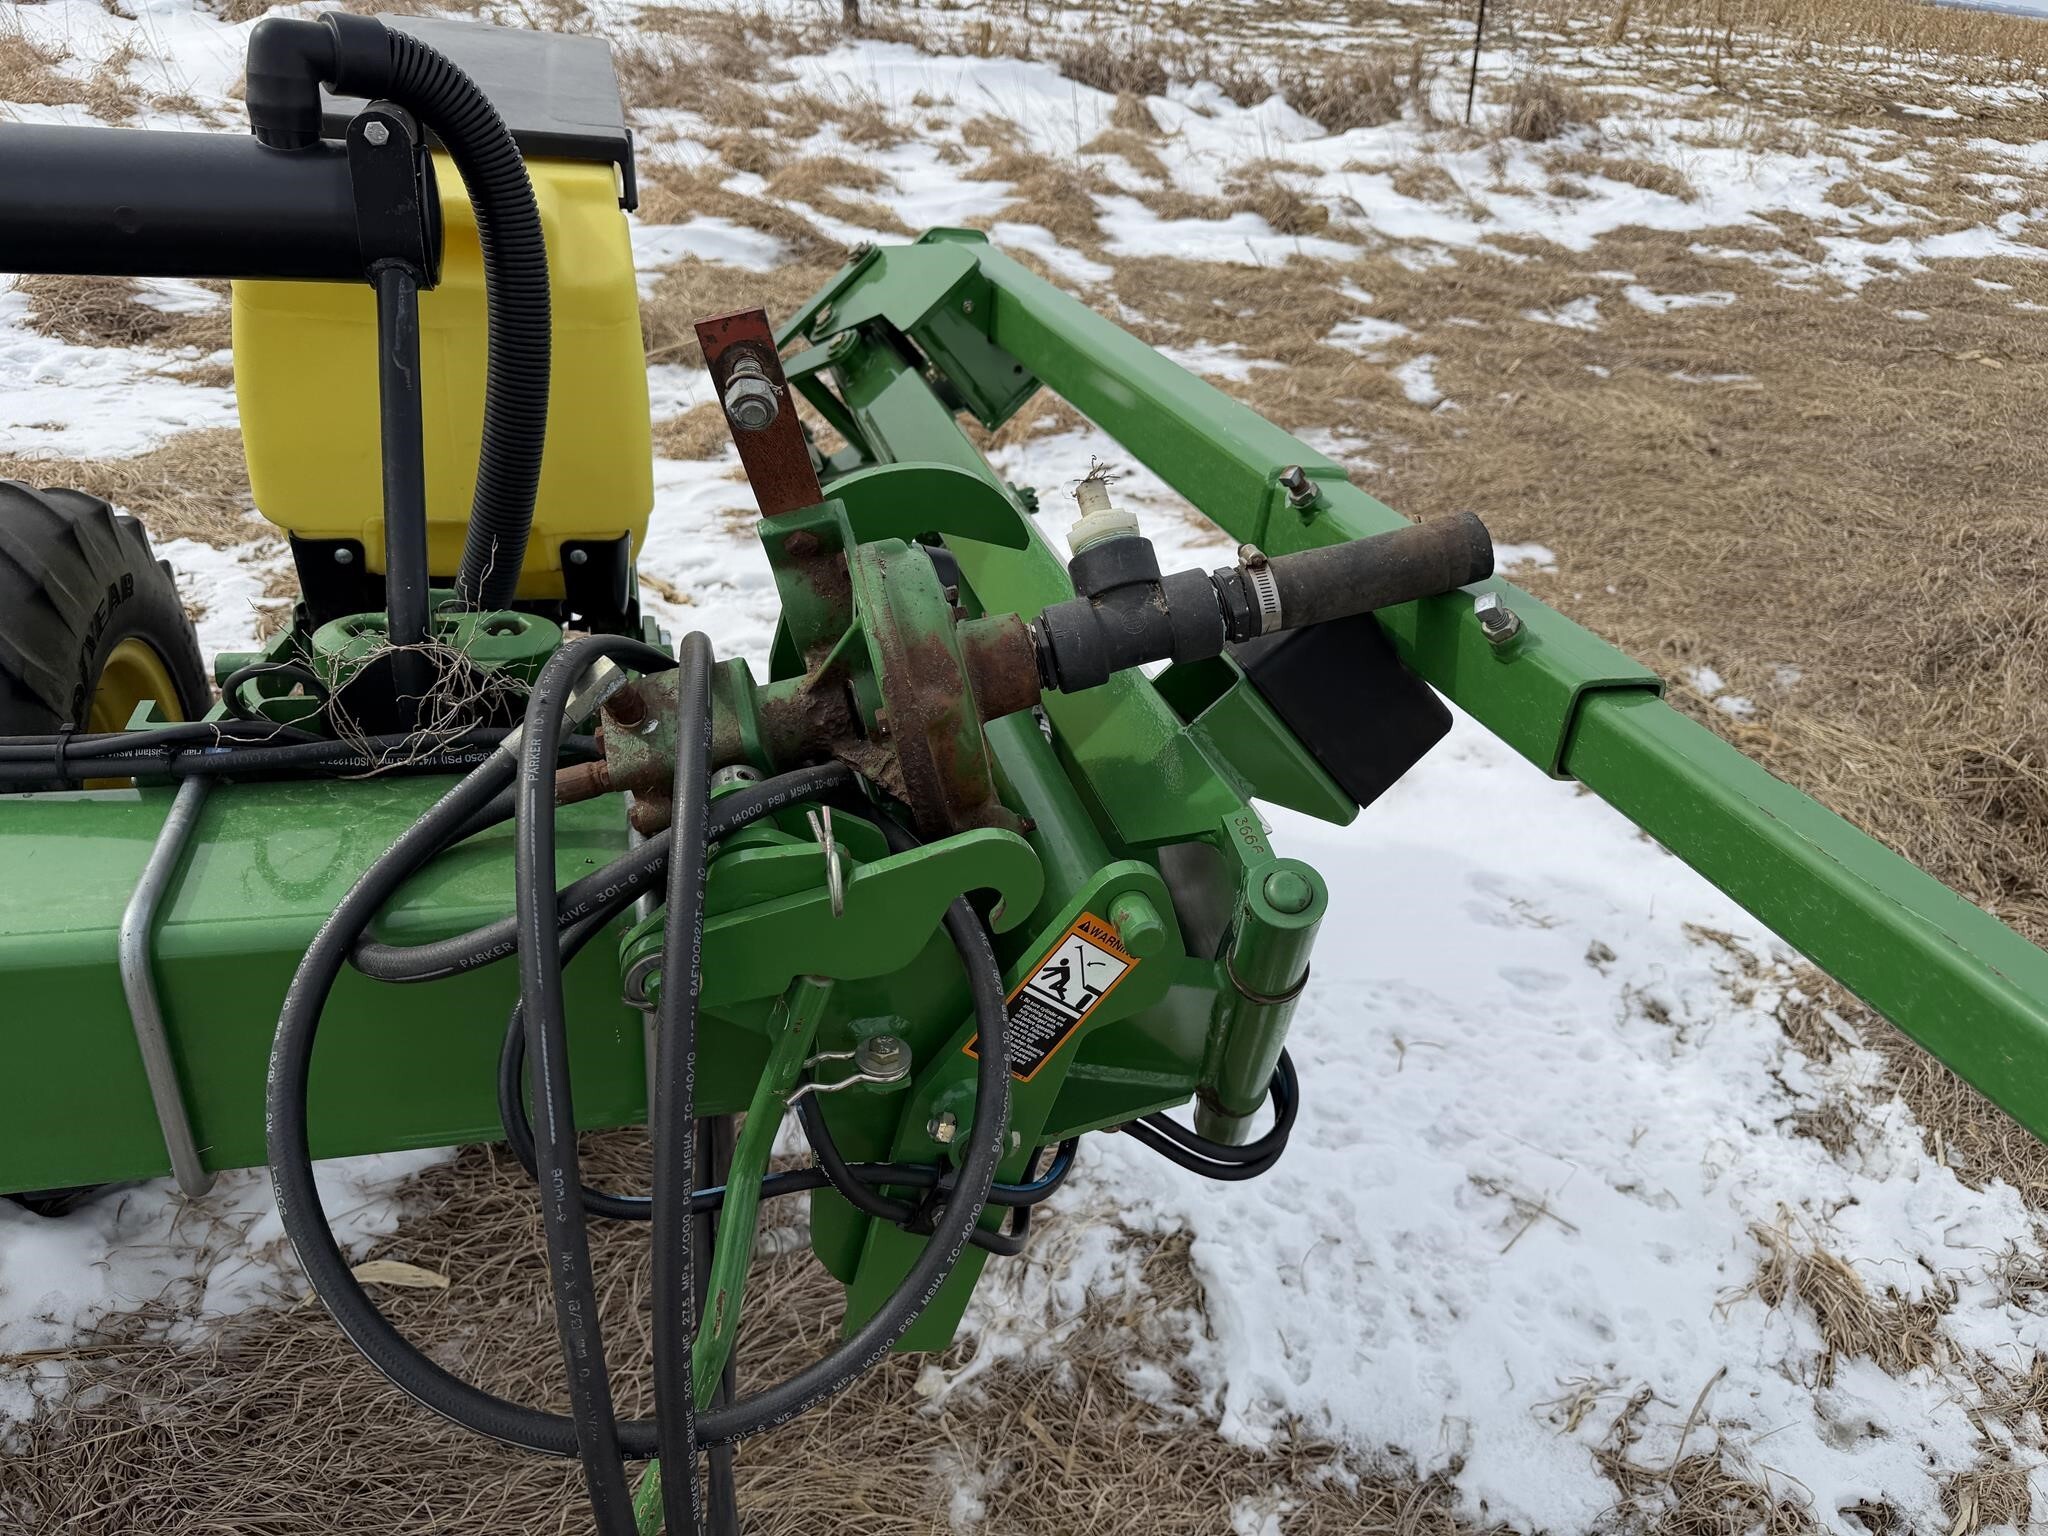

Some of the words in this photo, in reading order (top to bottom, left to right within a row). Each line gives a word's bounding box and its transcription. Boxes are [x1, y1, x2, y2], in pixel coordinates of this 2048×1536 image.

[526, 738, 541, 781] PARKER
[459, 939, 514, 968] PARKER
[596, 873, 638, 903] 301-6
[643, 856, 665, 875] WP
[682, 1130, 692, 1169] MSHA
[681, 1333, 691, 1352] WP
[722, 1422, 767, 1444] 301-6
[772, 1410, 794, 1425] WP
[830, 1370, 857, 1392] MPa
[919, 1269, 948, 1306] MSHA
[945, 1200, 981, 1267] IC-40/10
[681, 1359, 694, 1399] 301-6
